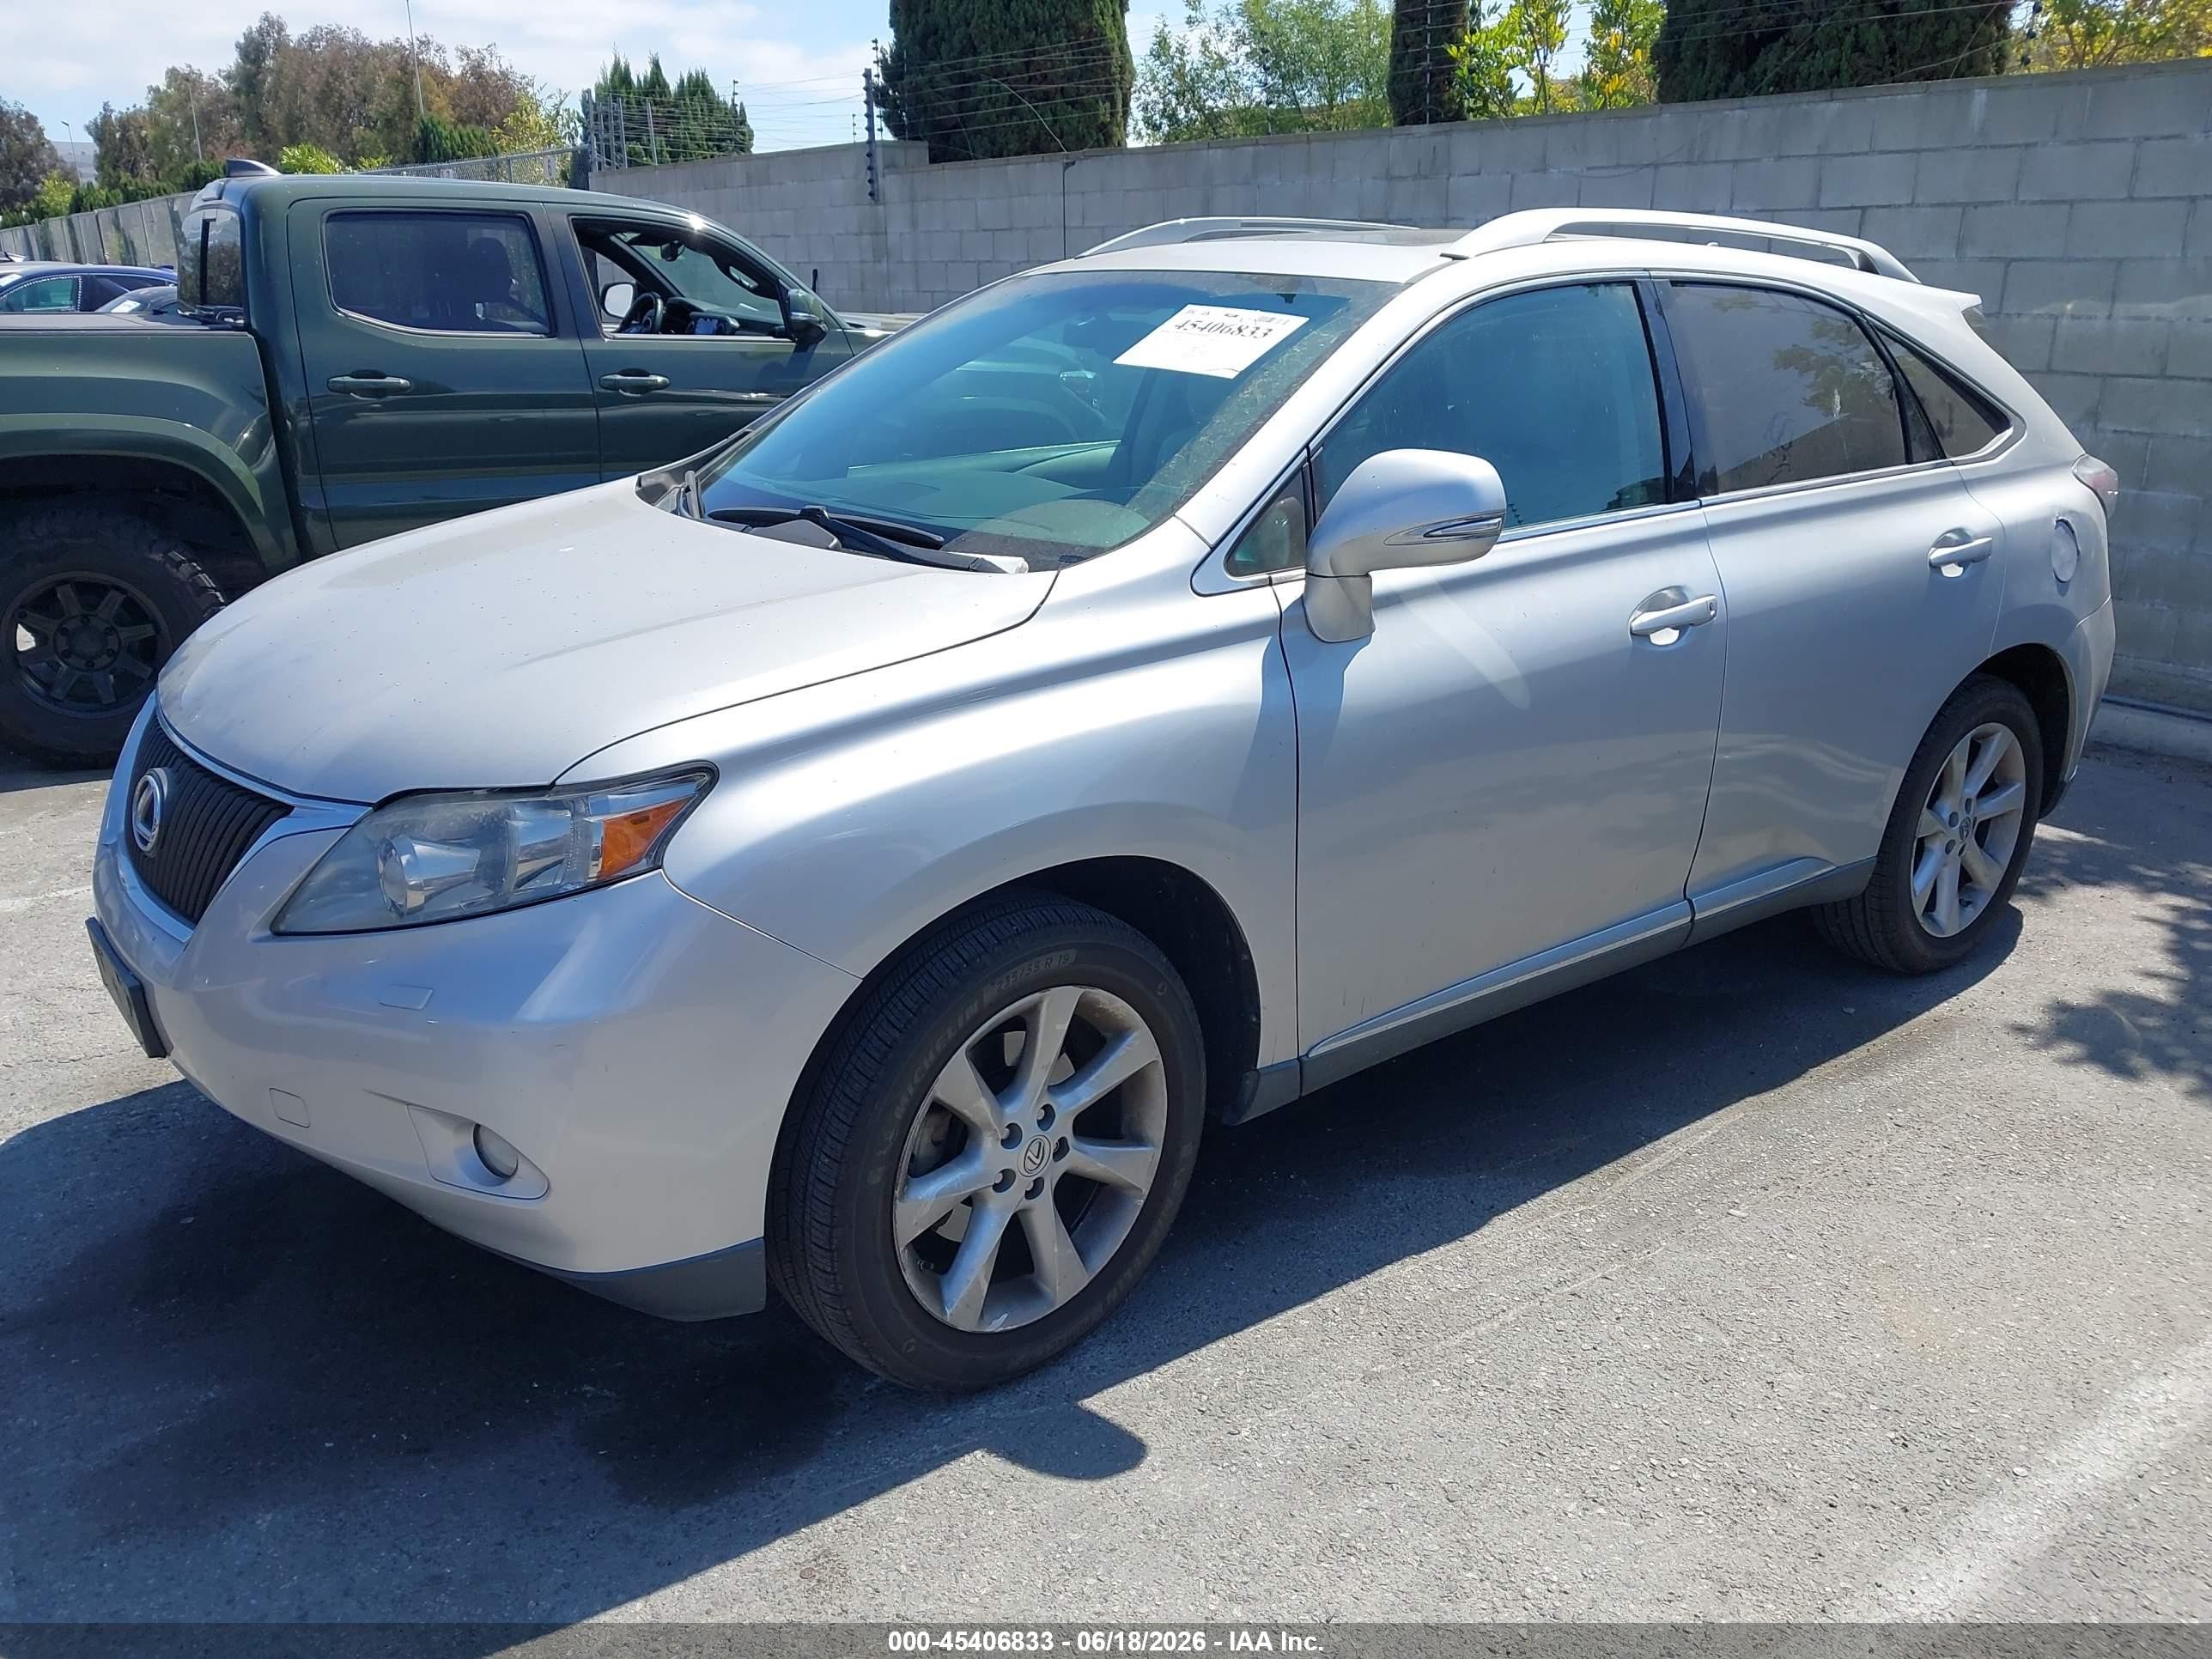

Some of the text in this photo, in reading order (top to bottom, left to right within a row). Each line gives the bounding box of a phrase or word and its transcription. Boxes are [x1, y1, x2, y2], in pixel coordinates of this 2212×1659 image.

[1175, 319, 1273, 339] 45406833
[1044, 955, 1054, 969] R
[1058, 952, 1071, 968] 19
